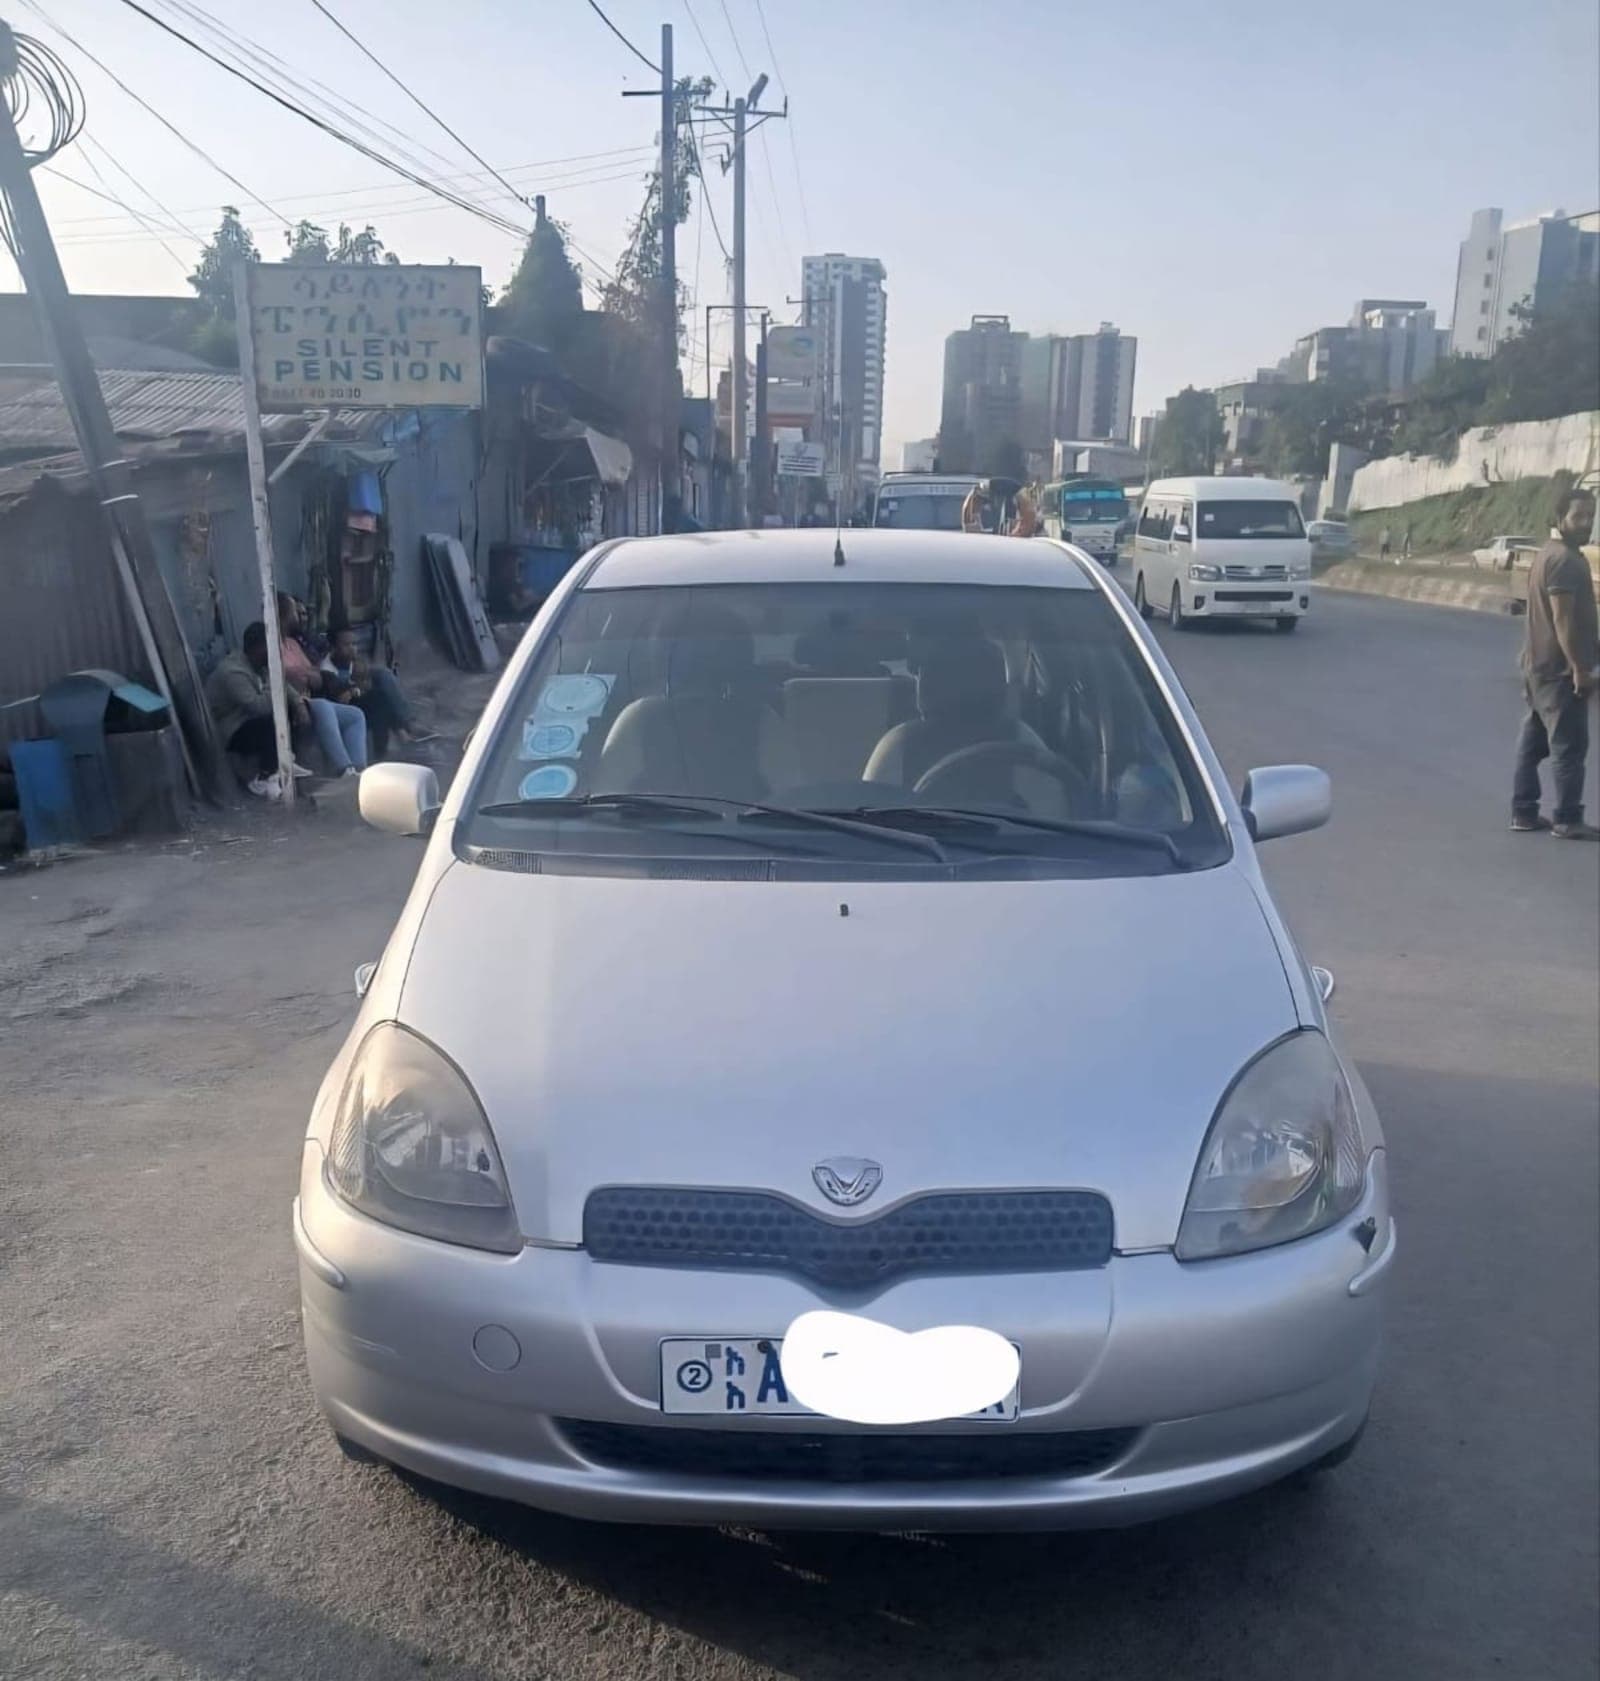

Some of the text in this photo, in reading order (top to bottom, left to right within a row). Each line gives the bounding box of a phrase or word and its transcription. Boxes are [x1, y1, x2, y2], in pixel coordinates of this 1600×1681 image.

[297, 338, 440, 358] SILENT
[275, 360, 463, 383] PENSION
[688, 1367, 702, 1386] 2
